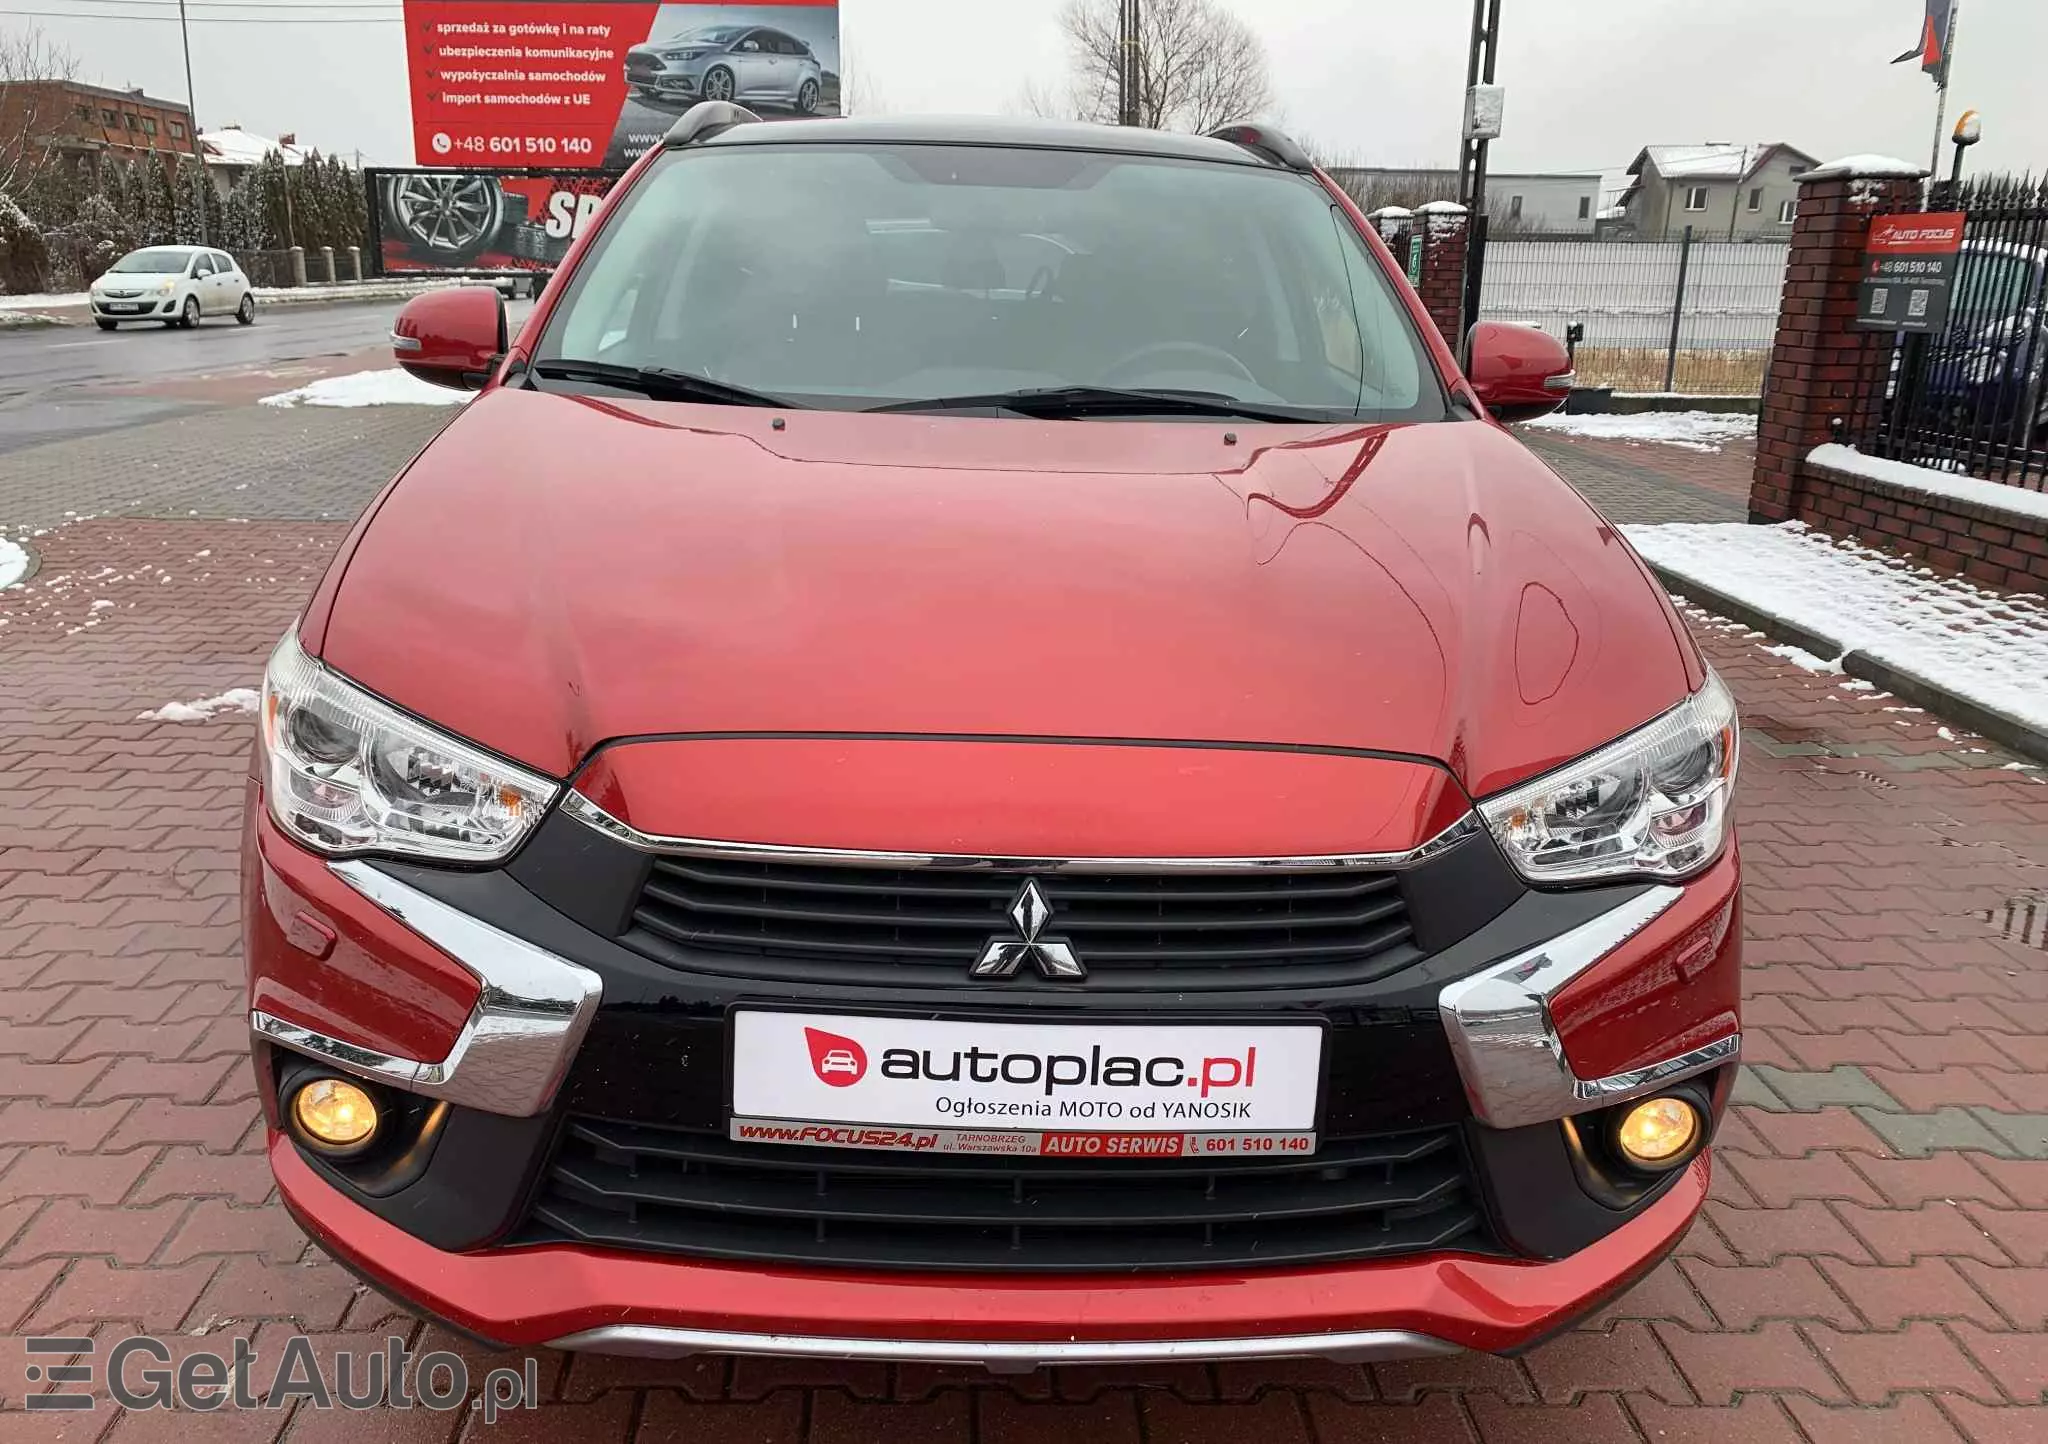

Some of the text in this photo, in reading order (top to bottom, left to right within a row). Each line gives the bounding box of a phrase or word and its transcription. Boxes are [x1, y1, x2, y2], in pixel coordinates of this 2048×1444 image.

[437, 22, 490, 36] sprzedaż
[492, 24, 506, 34] za
[508, 22, 561, 37] gotówkę
[569, 25, 585, 35] na
[586, 25, 611, 38] raty
[439, 45, 614, 62] ubezpieczenia komunikacyjne
[440, 69, 607, 83] wypożyczalnia samochodów
[484, 93, 561, 105] samochodów
[563, 96, 571, 105] z
[572, 93, 591, 105] UE
[454, 136, 592, 153] +48 601 510 140
[1892, 227, 1957, 241] AUTO FOCUS
[1893, 261, 1909, 273] 601
[1909, 261, 1926, 273] 510
[1926, 261, 1942, 273] 140
[880, 1045, 1257, 1099] autoplac.pl
[935, 1096, 1253, 1119] Ogłoszenia MOTO od YANOSIK
[956, 1133, 1027, 1144] TARNOBRZEG
[1045, 1137, 1310, 1155] AUTO SERWIS 601 510 140
[943, 1143, 1037, 1153] ul. Warszawska 10a
